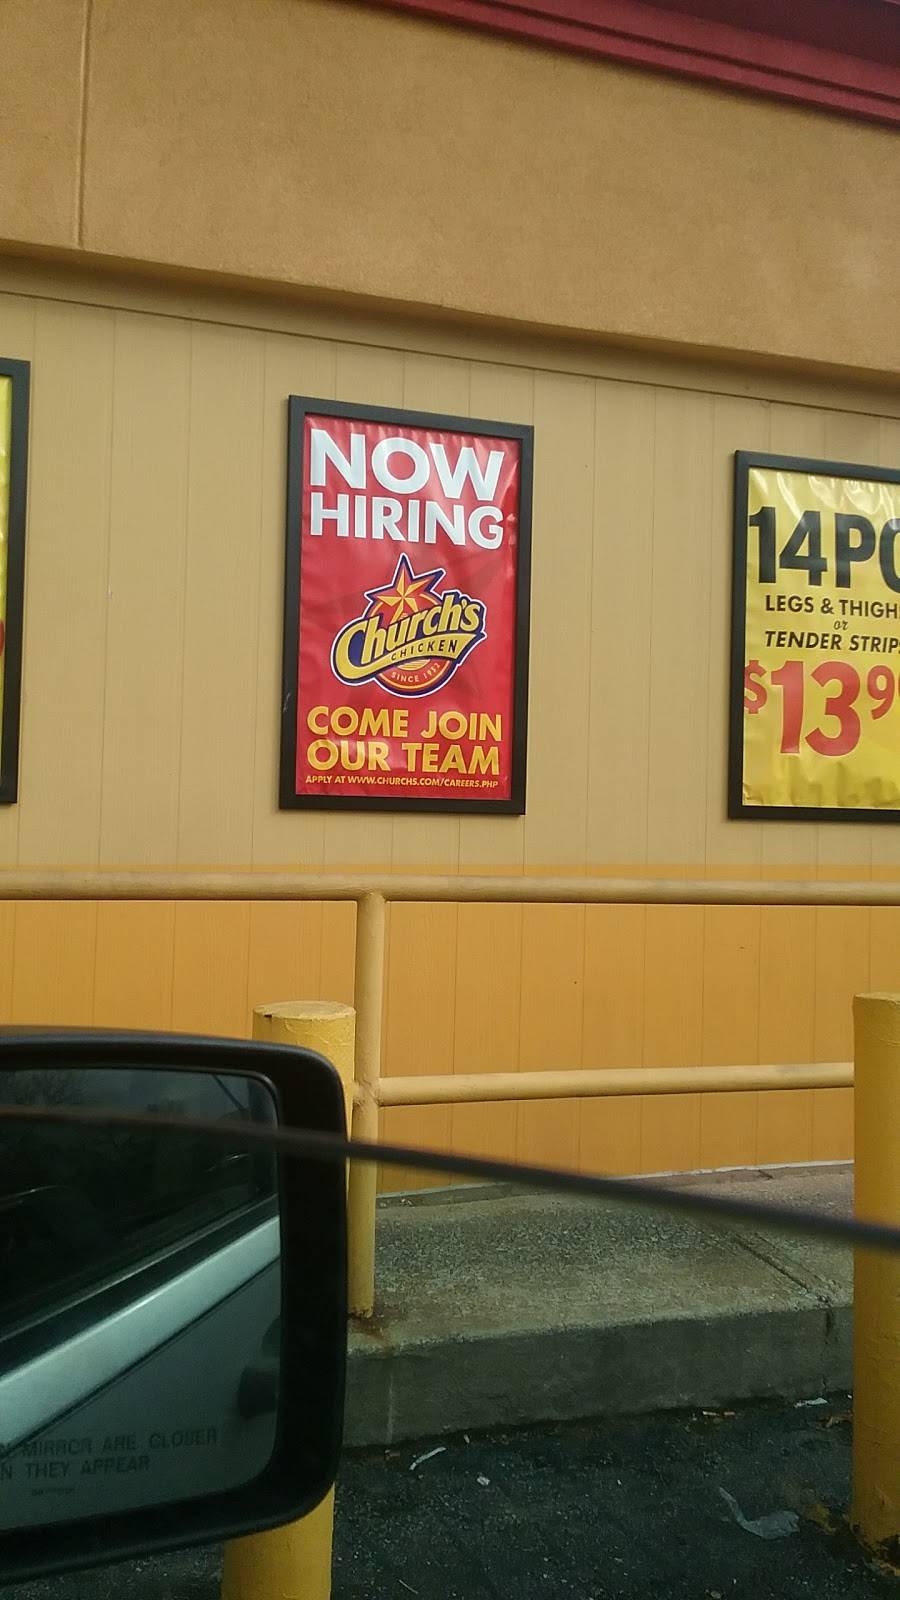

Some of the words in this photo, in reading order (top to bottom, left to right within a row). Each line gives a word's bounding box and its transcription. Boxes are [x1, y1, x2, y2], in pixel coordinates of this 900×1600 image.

[310, 428, 505, 501] NOW
[310, 492, 504, 549] HIRING
[766, 595, 814, 613] LEGS
[821, 598, 834, 615] &
[839, 599, 900, 619] THIGH
[335, 594, 480, 679] Church's
[833, 620, 849, 631] or
[391, 639, 458, 661] CHICKEN
[765, 631, 842, 651] TENDER
[391, 671, 420, 683] SINCE
[423, 662, 441, 680] 1952
[306, 705, 409, 737] COME
[420, 710, 502, 742] JOIN
[306, 739, 391, 771] OUR
[401, 743, 500, 776] TEAM
[305, 775, 332, 784] APPLY
[334, 776, 345, 784] AT
[347, 776, 499, 788] WWW.CHURCHS.COM/CAREERS.PHP
[21, 1437, 92, 1457] MIRROR
[103, 1433, 137, 1451] ARE
[25, 1461, 70, 1479] THEY
[80, 1455, 150, 1475] APPEAR
